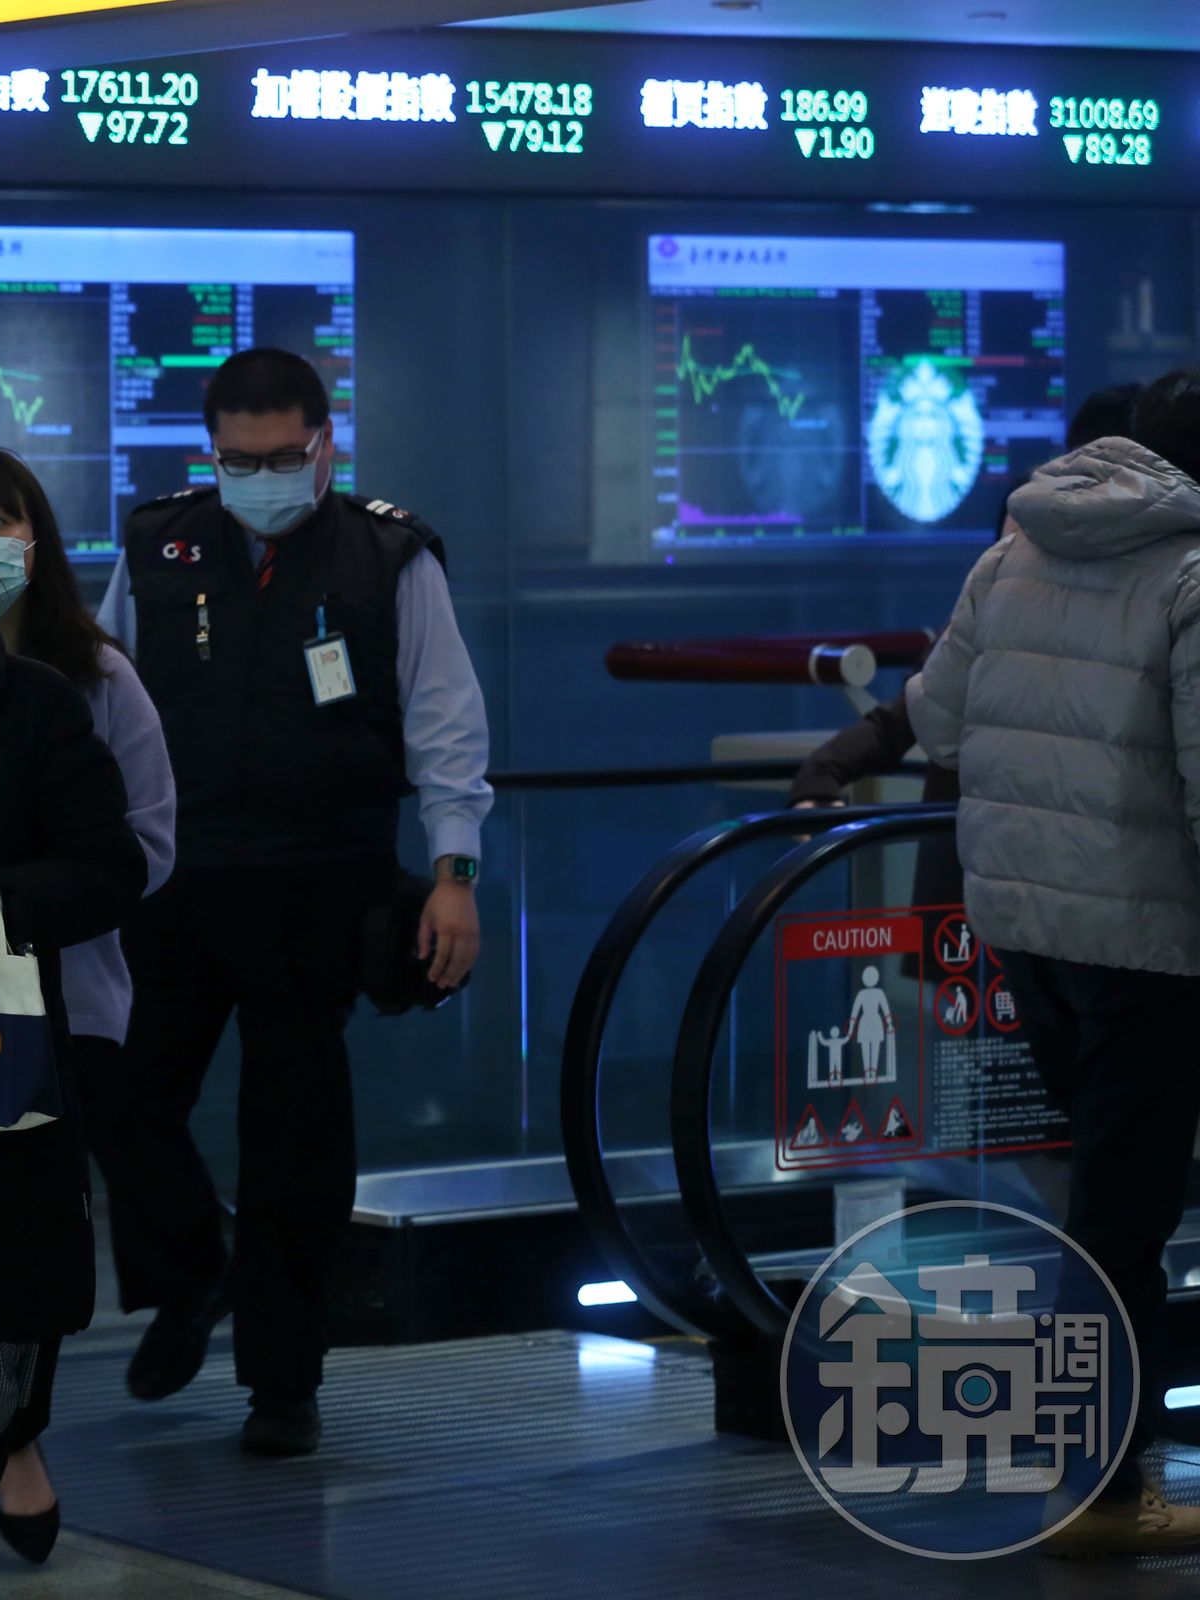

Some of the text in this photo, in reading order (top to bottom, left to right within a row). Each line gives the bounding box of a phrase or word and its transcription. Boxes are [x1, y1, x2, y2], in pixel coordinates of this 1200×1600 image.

[60, 69, 198, 106] 17611.20
[465, 80, 593, 117] 15478.18
[780, 88, 868, 123] 186.99
[1049, 97, 1161, 131] 31008.69
[106, 110, 189, 145] 97.72
[504, 119, 584, 153] 79.12
[818, 126, 875, 159] 1.90
[1085, 132, 1152, 166] 89.28
[813, 926, 892, 952] CAUTION
